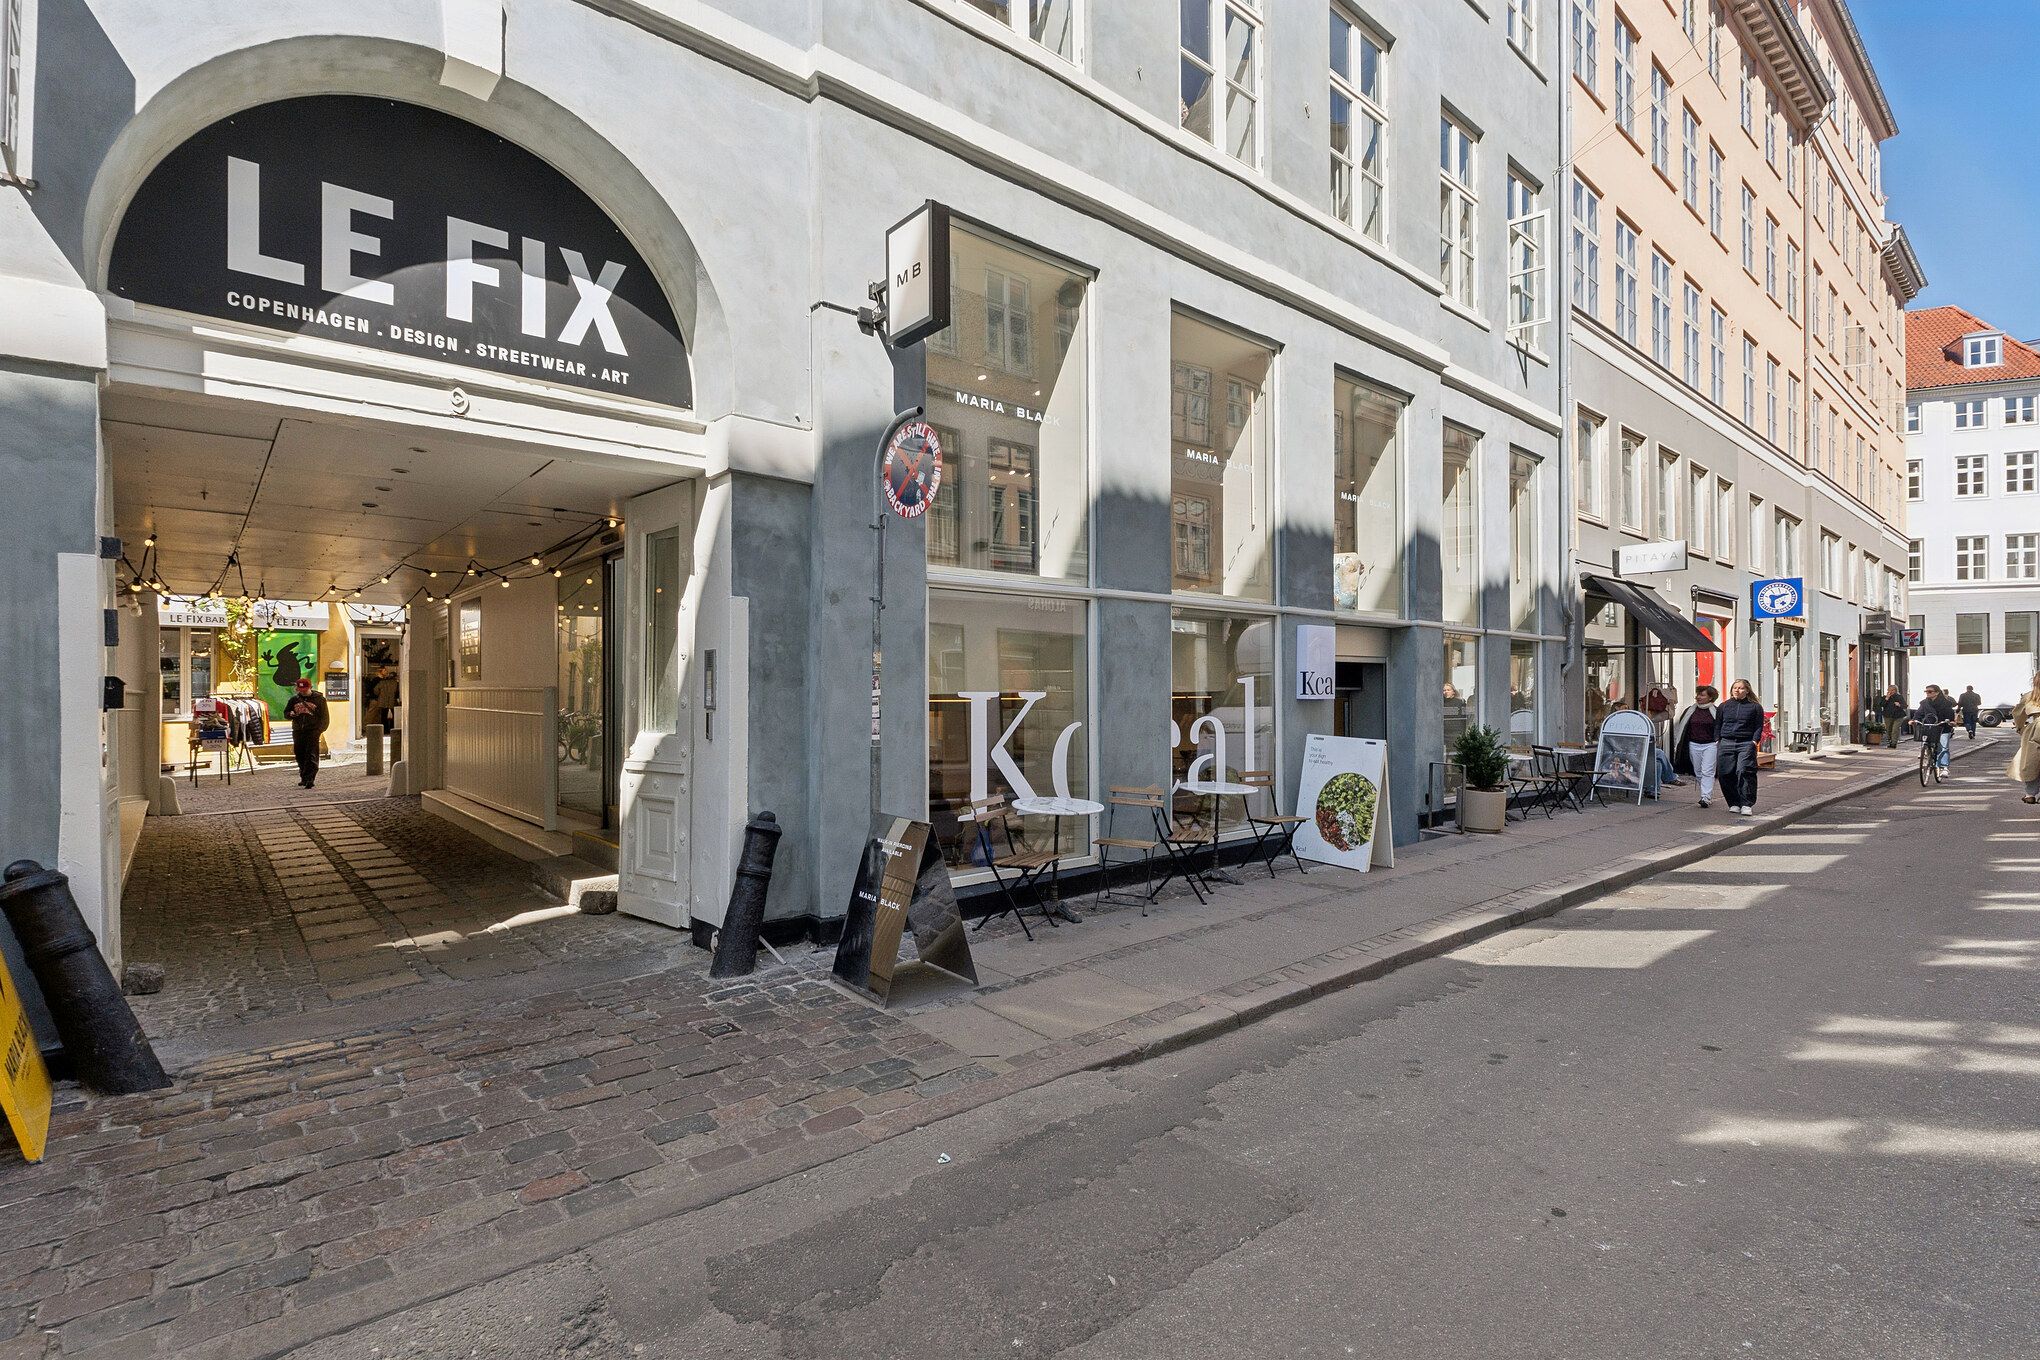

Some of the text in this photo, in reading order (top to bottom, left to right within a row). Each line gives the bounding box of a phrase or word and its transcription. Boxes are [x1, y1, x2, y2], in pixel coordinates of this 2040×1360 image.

[227, 156, 628, 356] LE FIX
[227, 291, 630, 385] COPENHAGEN DESIGN STREETWEAR ART
[956, 391, 1061, 426] MARIA BLACK
[885, 446, 896, 465] WE
[893, 428, 907, 450] ARE
[907, 423, 927, 439] STILL
[1186, 449, 1219, 465] MARIA
[887, 487, 926, 518] BACKYARD
[1625, 551, 1679, 563] PITAYA
[170, 614, 225, 624] LE FIX BAR
[277, 618, 307, 627] LE FIX
[1610, 722, 1643, 731] PITAYA
[859, 890, 901, 910] MARIA BLACK
